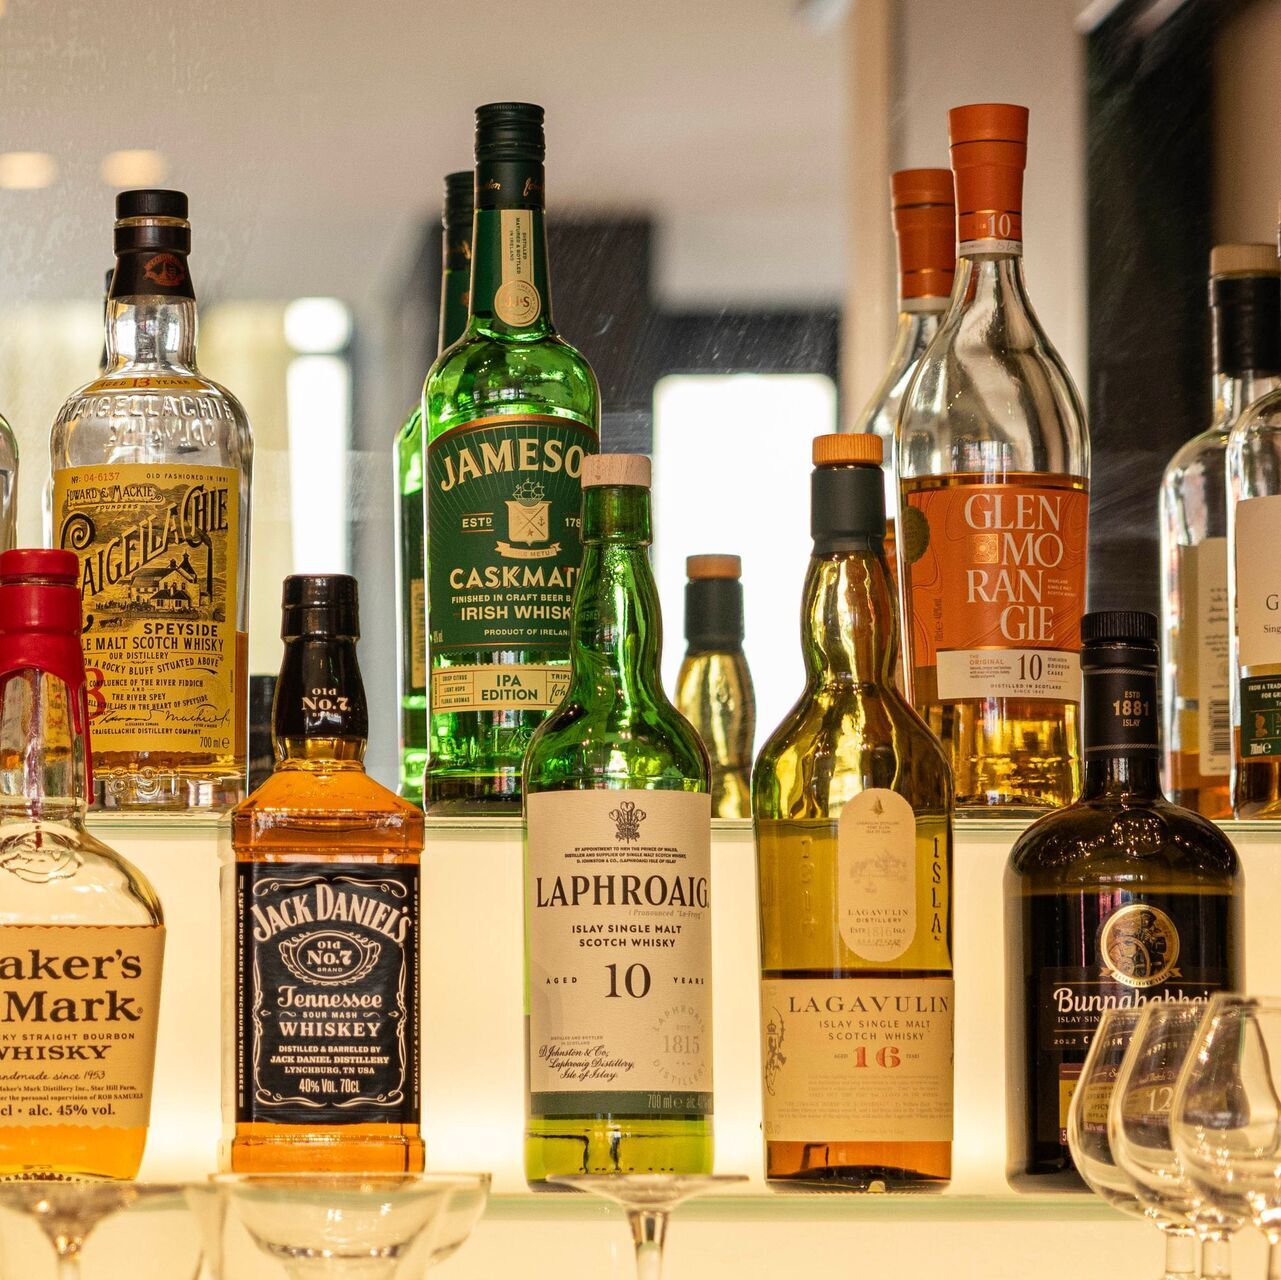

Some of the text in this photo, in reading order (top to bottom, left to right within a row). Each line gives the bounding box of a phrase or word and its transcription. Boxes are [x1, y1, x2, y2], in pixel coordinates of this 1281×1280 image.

[440, 438, 584, 492] JAMESO
[964, 494, 1060, 531] GLEN
[1002, 533, 1064, 568] MO
[967, 570, 1044, 604] RAN
[461, 607, 508, 620] IRISH
[144, 623, 217, 637] SPEYSIDE
[999, 606, 1054, 642] GIE
[1018, 653, 1042, 681] 10
[497, 674, 521, 686] IPA
[482, 690, 538, 700] EDITION
[1112, 701, 1149, 716] 1881
[1122, 718, 1140, 727] ISLAY
[536, 875, 708, 909] LAPHROAIG
[250, 884, 412, 944] JACK DANIEL'S
[572, 924, 682, 934] ISLAY SINGLE MALT
[318, 940, 340, 950] Old
[579, 938, 675, 948] SCOTCH WHISKY
[546, 963, 704, 998] AGED 10 YEARS
[278, 985, 382, 1008] Tennessee
[4, 991, 140, 1022] Mark
[790, 995, 949, 1014] LAGAVULIN
[280, 1022, 380, 1037] WHISKEY
[820, 1020, 931, 1029] ISLAY SINGLE MALT
[828, 1031, 925, 1041] SCOTCH WHISKY
[334, 1056, 389, 1064] DISTILLERY
[853, 1046, 900, 1068] 16
[53, 1073, 79, 1081] since
[83, 1071, 105, 1080] 1953
[299, 1079, 319, 1092] 40%
[0, 1105, 12, 1116] cl
[29, 1105, 52, 1116] alc.
[56, 1105, 87, 1116] 45%
[92, 1105, 115, 1116] vol.
